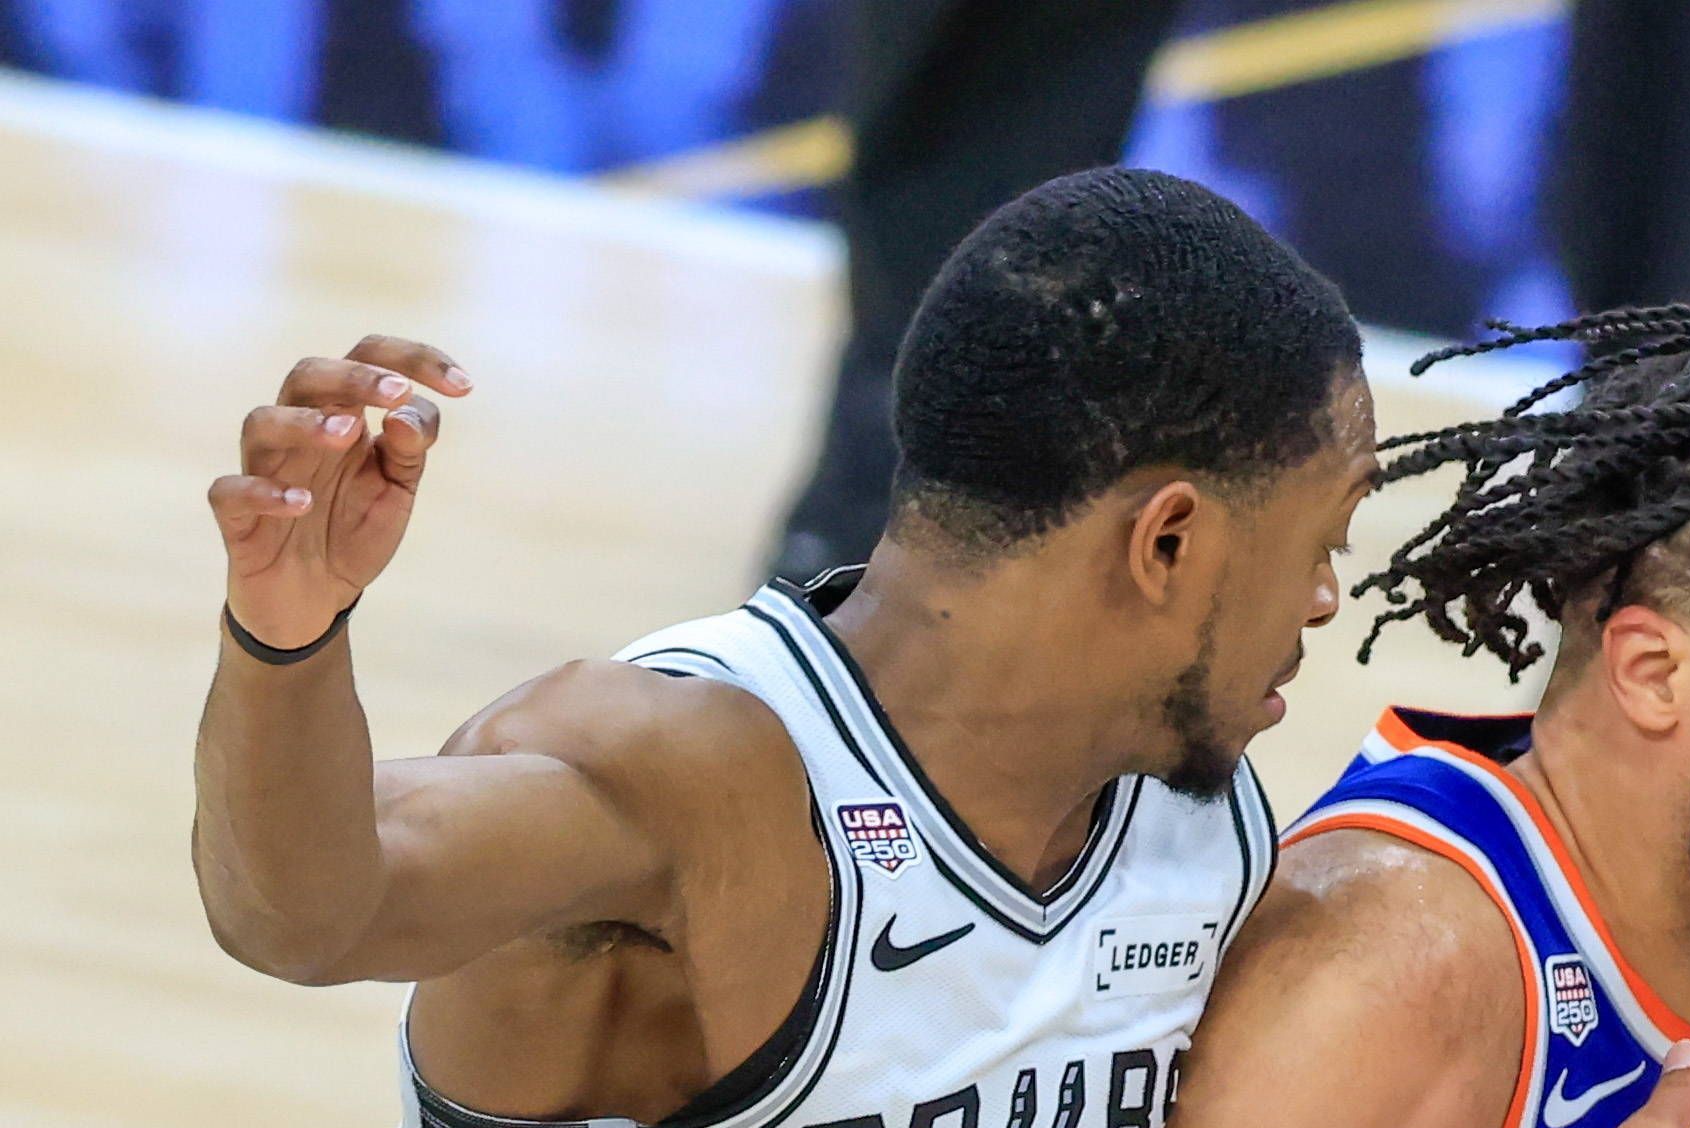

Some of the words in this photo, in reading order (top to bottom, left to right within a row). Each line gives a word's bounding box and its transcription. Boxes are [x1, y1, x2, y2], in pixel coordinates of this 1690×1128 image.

[842, 808, 903, 829] USA
[851, 839, 917, 860] 250
[1110, 940, 1200, 973] LEDGER
[1554, 966, 1586, 989] USA
[1557, 999, 1596, 1026] 250
